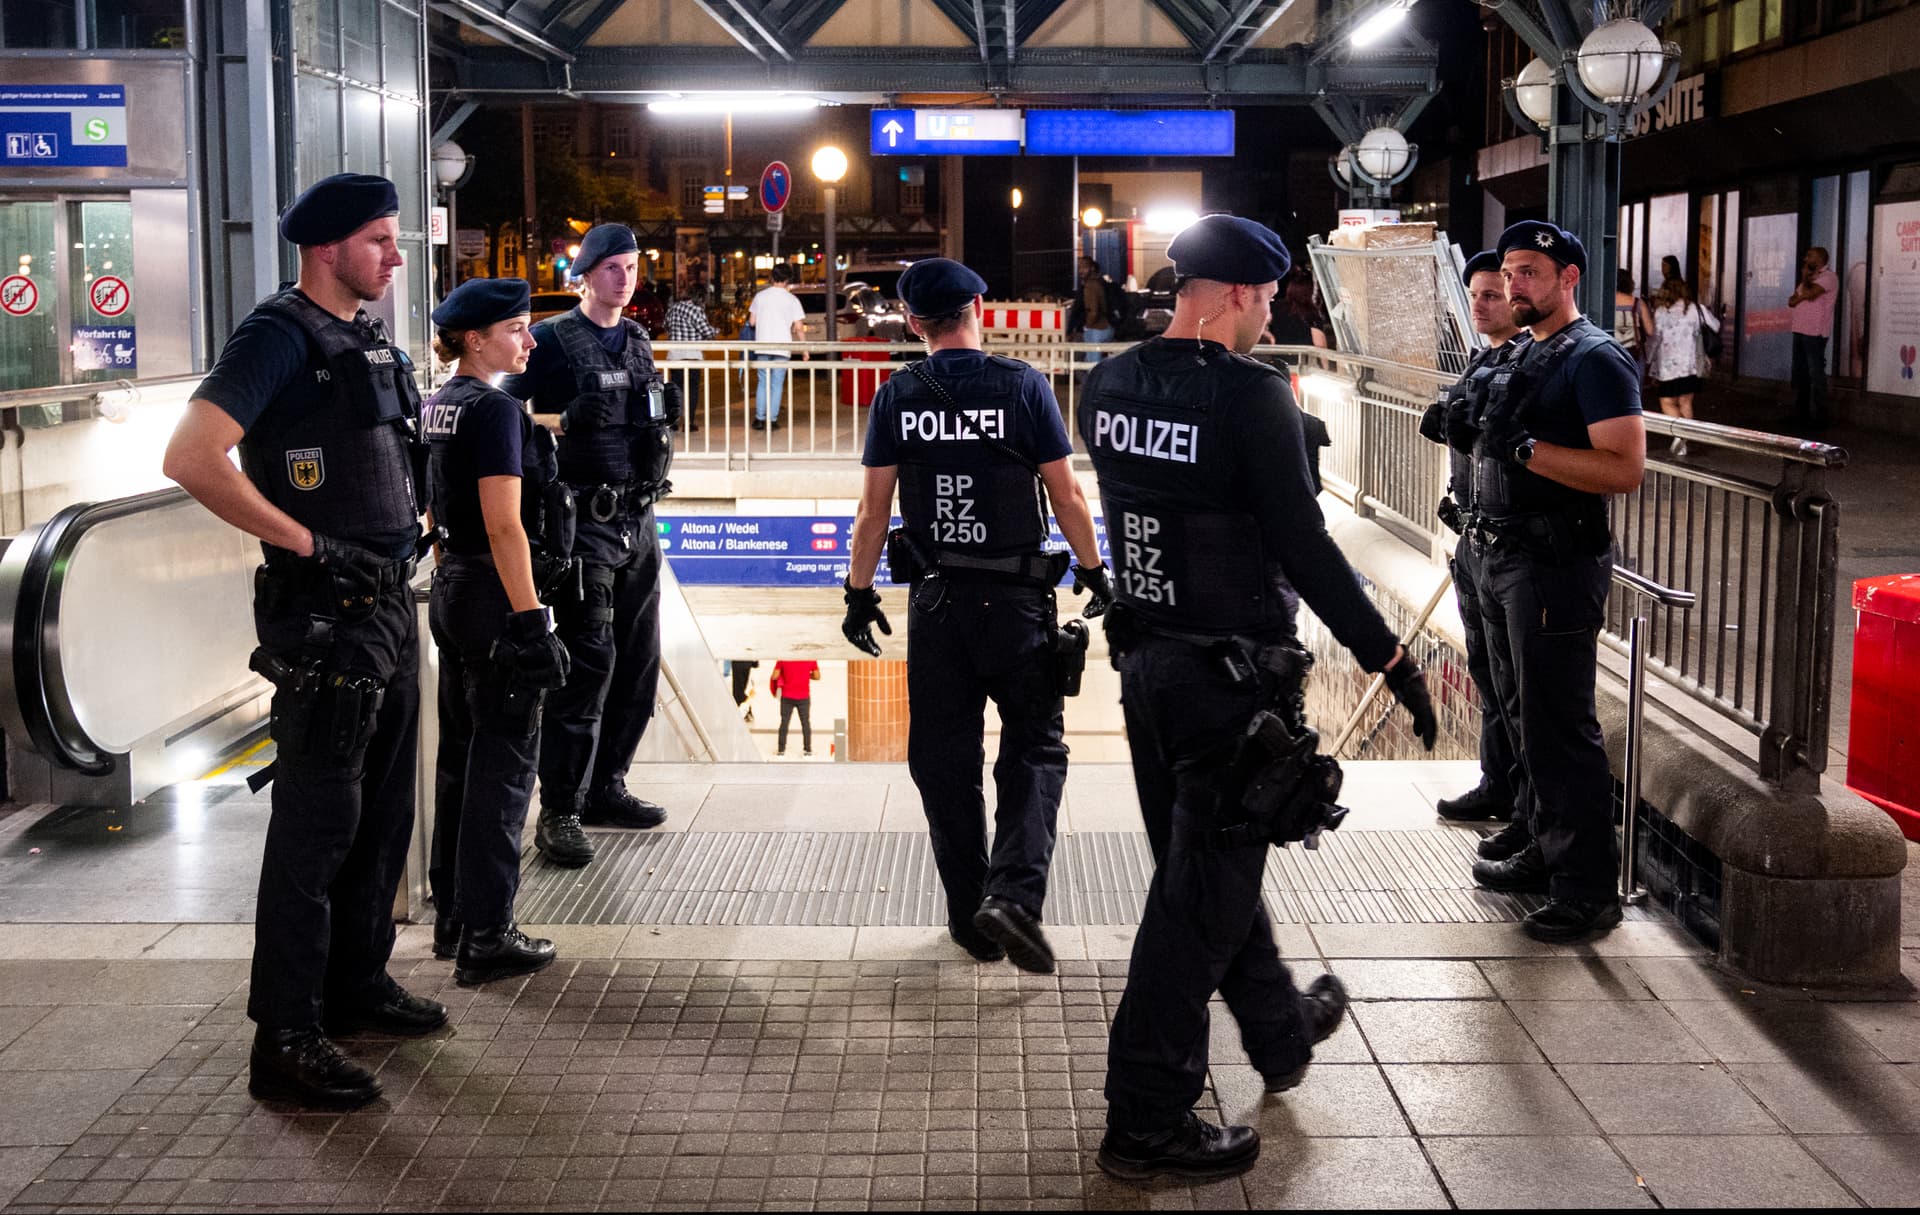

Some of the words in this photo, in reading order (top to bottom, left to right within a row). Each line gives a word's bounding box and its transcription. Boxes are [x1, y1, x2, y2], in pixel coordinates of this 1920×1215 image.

[1656, 73, 1704, 130] SUITE
[1896, 221, 1920, 237] CAMP
[1901, 237, 1920, 252] SUIT
[77, 330, 116, 339] Vorfahrt
[118, 330, 131, 339] für
[365, 348, 395, 365] POLIZEI
[422, 403, 462, 435] OLIZEI
[901, 409, 1005, 441] POLIZEI
[1095, 410, 1198, 463] POLIZEI
[289, 450, 320, 462] POLIZEI
[936, 474, 973, 497] BP
[936, 499, 975, 520] RZ
[681, 522, 718, 534] Altona
[725, 522, 759, 534] Wedel
[930, 521, 987, 544] 1250
[1123, 511, 1160, 543] BP
[681, 538, 718, 550] Altona
[725, 538, 788, 550] Blankenese
[786, 562, 817, 572] Zugang
[833, 563, 847, 571] mit
[1124, 542, 1164, 576] RZ
[1121, 569, 1176, 606] 1251
